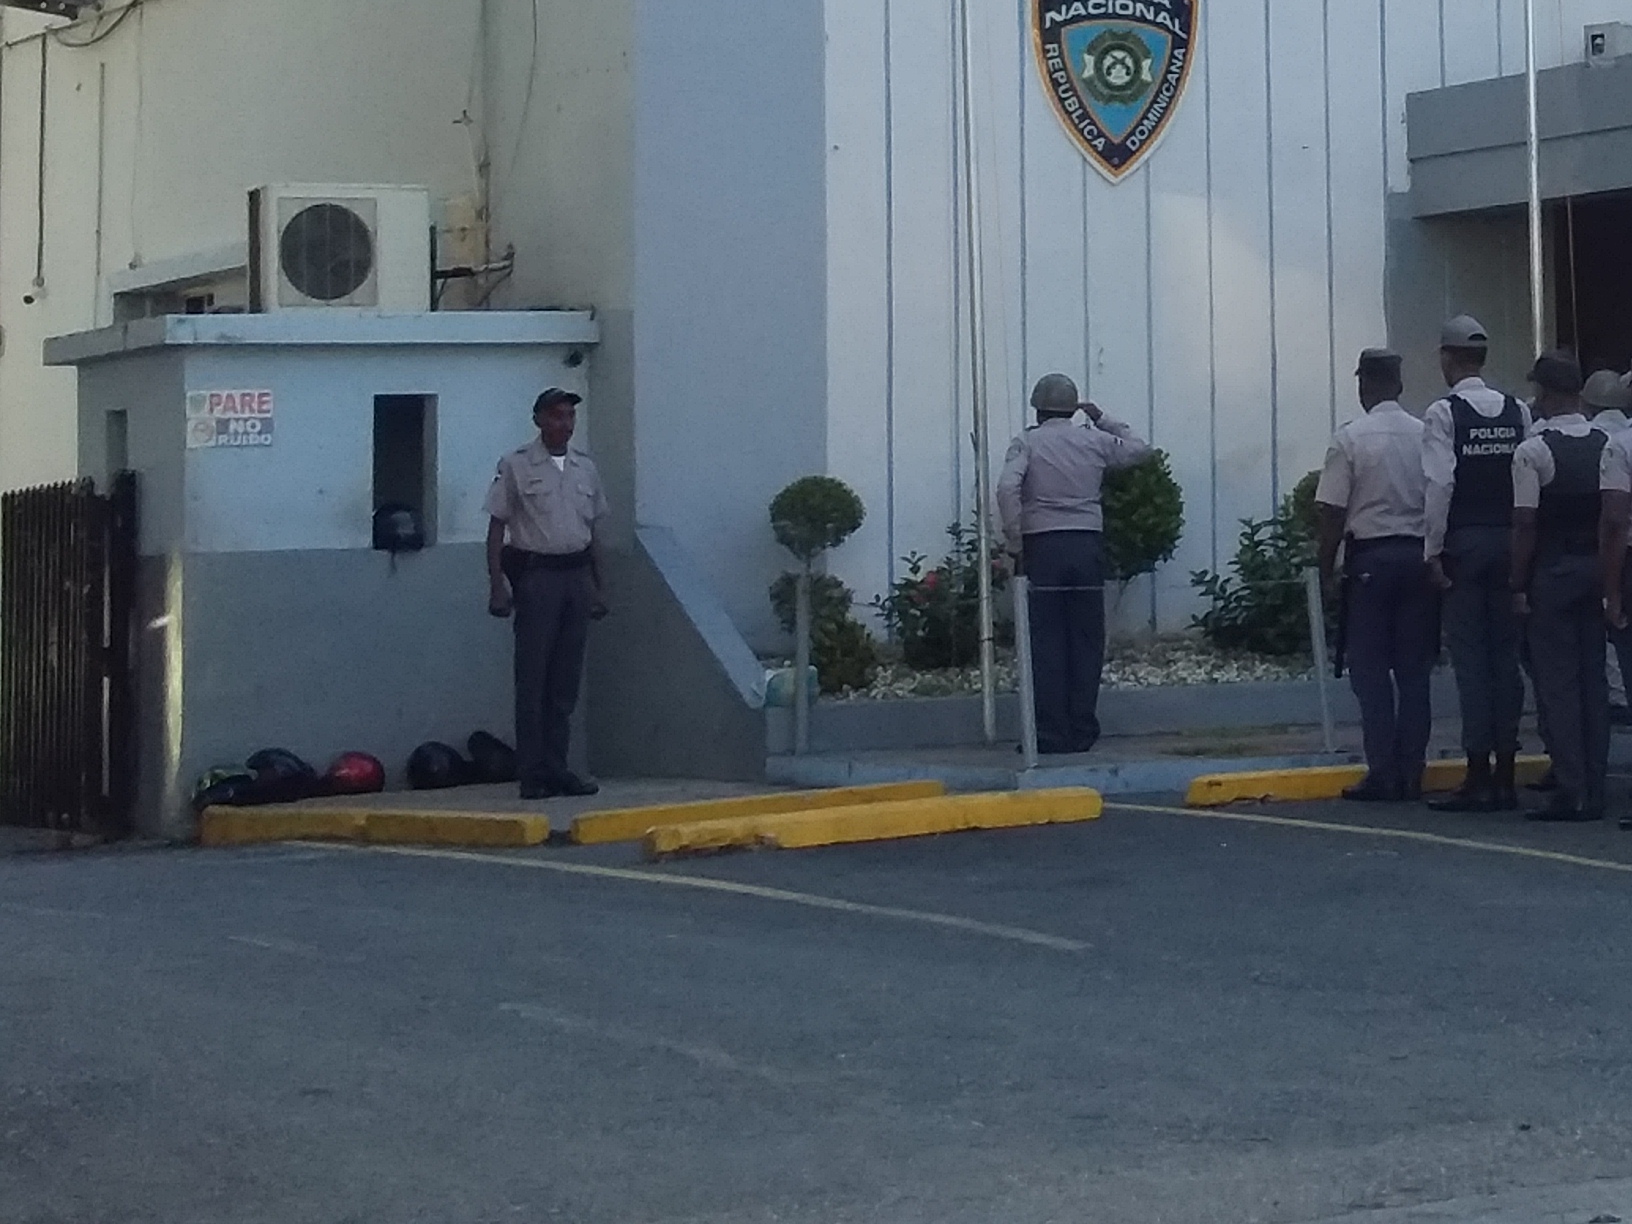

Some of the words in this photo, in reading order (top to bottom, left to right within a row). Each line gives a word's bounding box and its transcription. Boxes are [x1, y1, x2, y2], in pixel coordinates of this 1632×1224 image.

[1044, 43, 1106, 152] REPUBLICA
[1125, 48, 1186, 152] DOMINICANA
[208, 392, 272, 415] PARE
[228, 418, 261, 434] NO
[1469, 426, 1517, 440] POLICIA
